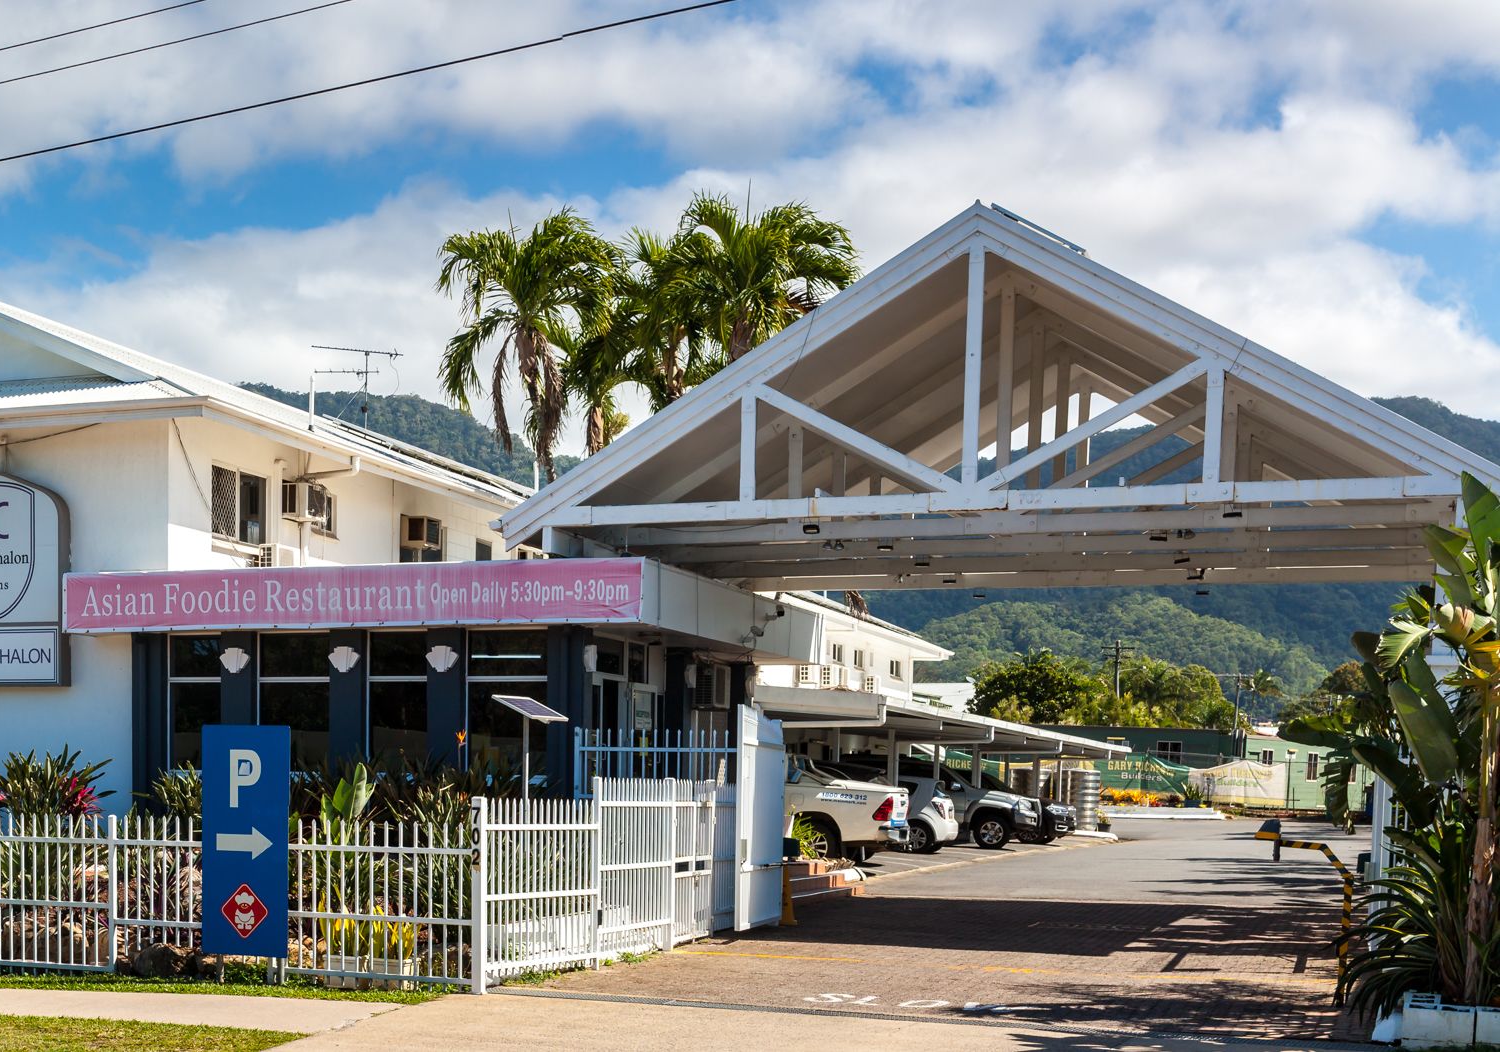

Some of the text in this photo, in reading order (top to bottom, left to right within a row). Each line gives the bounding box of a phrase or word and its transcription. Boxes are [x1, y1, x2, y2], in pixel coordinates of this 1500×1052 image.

[81, 579, 629, 617] Asian Foodie Restaurant Open Daily 5:30pm-9:30pm
[229, 749, 262, 808] P
[1107, 760, 1134, 771] GARY
[1121, 772, 1163, 782] Builders
[472, 807, 480, 866] 702
